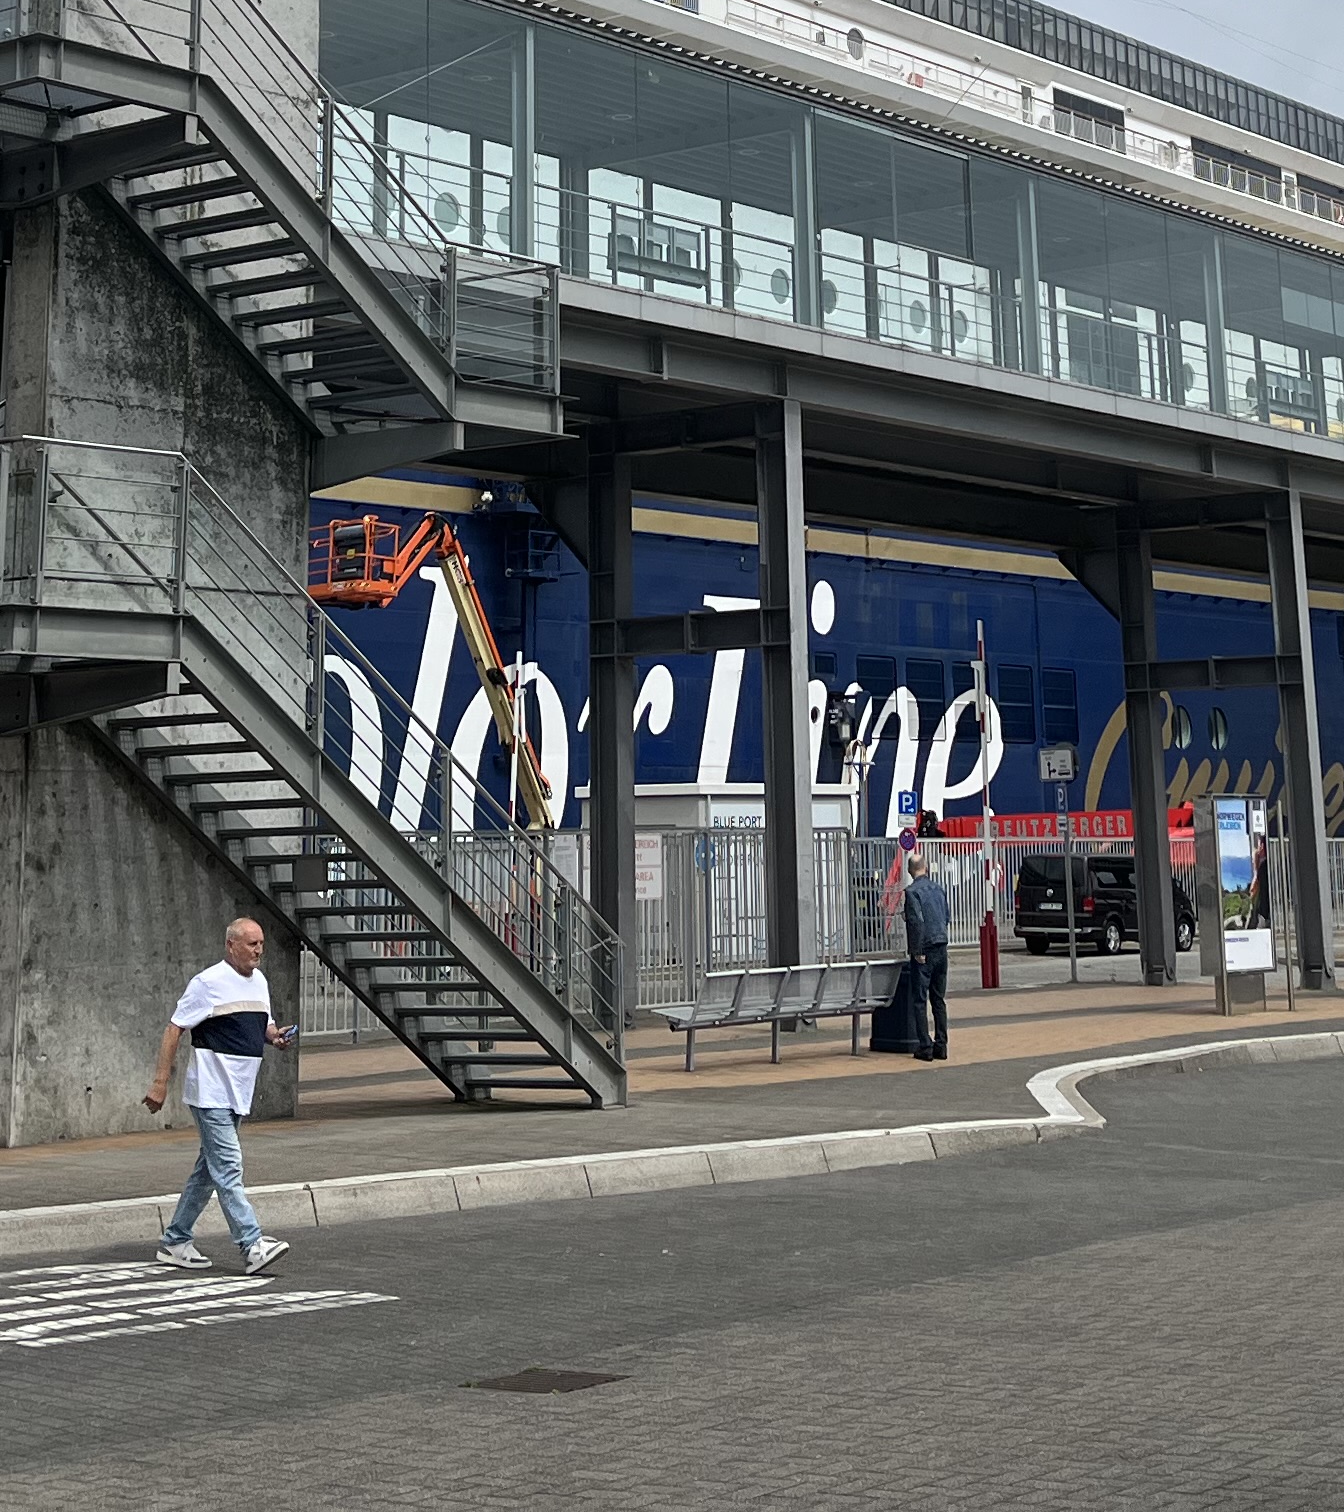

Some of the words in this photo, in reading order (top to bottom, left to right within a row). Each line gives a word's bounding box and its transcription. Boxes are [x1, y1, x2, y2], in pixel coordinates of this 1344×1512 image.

[902, 794, 913, 812] P
[713, 816, 736, 829] BLUE
[738, 815, 762, 828] PORT
